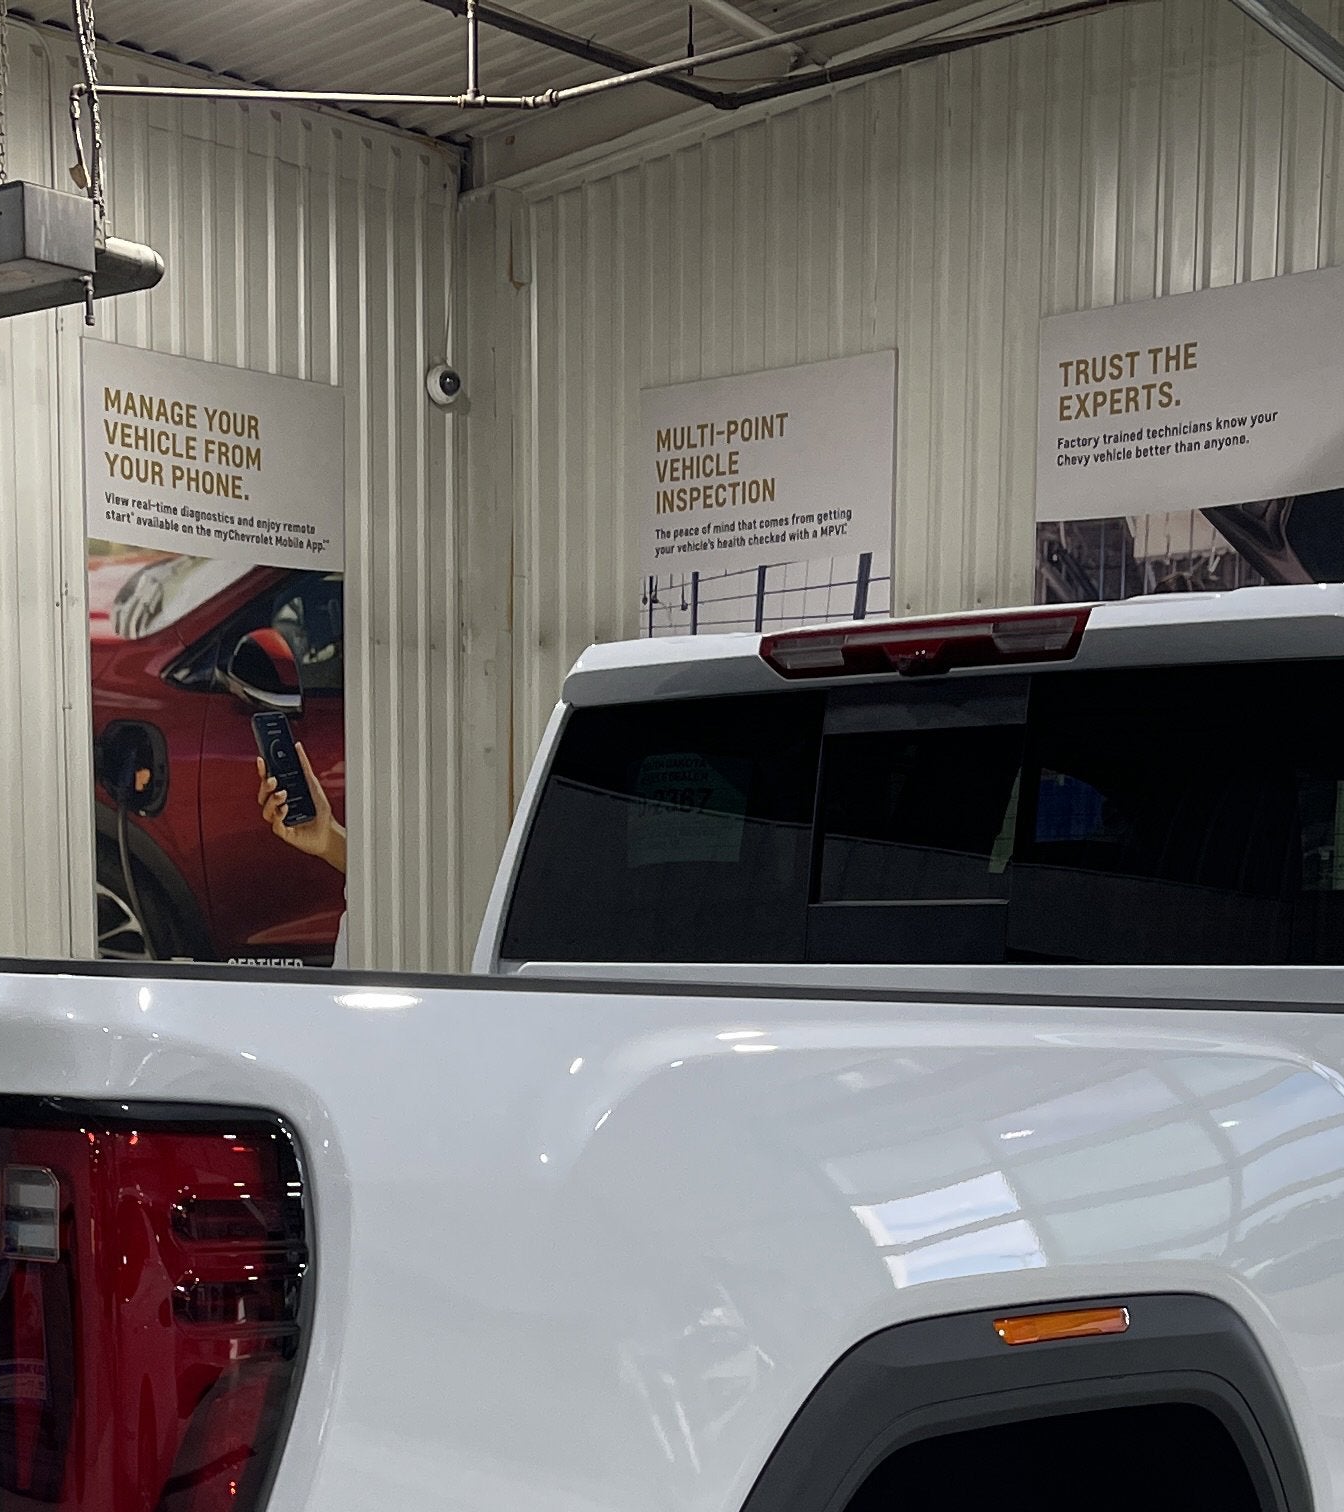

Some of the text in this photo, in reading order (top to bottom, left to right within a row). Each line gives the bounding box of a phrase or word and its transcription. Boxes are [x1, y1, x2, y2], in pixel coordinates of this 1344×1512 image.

[1059, 342, 1198, 387] TRUST THE
[104, 387, 259, 440] MANAGE YOUR
[1059, 381, 1181, 422] EXPERTS.
[104, 420, 261, 471] VEHICLE FROM
[656, 412, 788, 452] MULTI-POINT
[1057, 411, 1278, 450] Factory trained technicians know your
[656, 451, 740, 483] VEHICLE
[1057, 434, 1250, 468] Chevy vehicle better than anyone.
[104, 452, 250, 500] YOUR PHONE.
[105, 492, 316, 535] View real-time diagnostics and enjoy remote
[656, 478, 776, 514] INSPECTION
[136, 514, 179, 532] available
[182, 523, 194, 534] on
[196, 523, 212, 537] the
[214, 527, 273, 546] myChevrolet
[275, 536, 304, 550] Mobile
[654, 543, 676, 558] your
[716, 535, 746, 550] health
[748, 532, 786, 546] checked
[789, 528, 810, 542] with
[812, 530, 818, 539] a
[655, 508, 852, 542] The peace of mind that comes from getting
